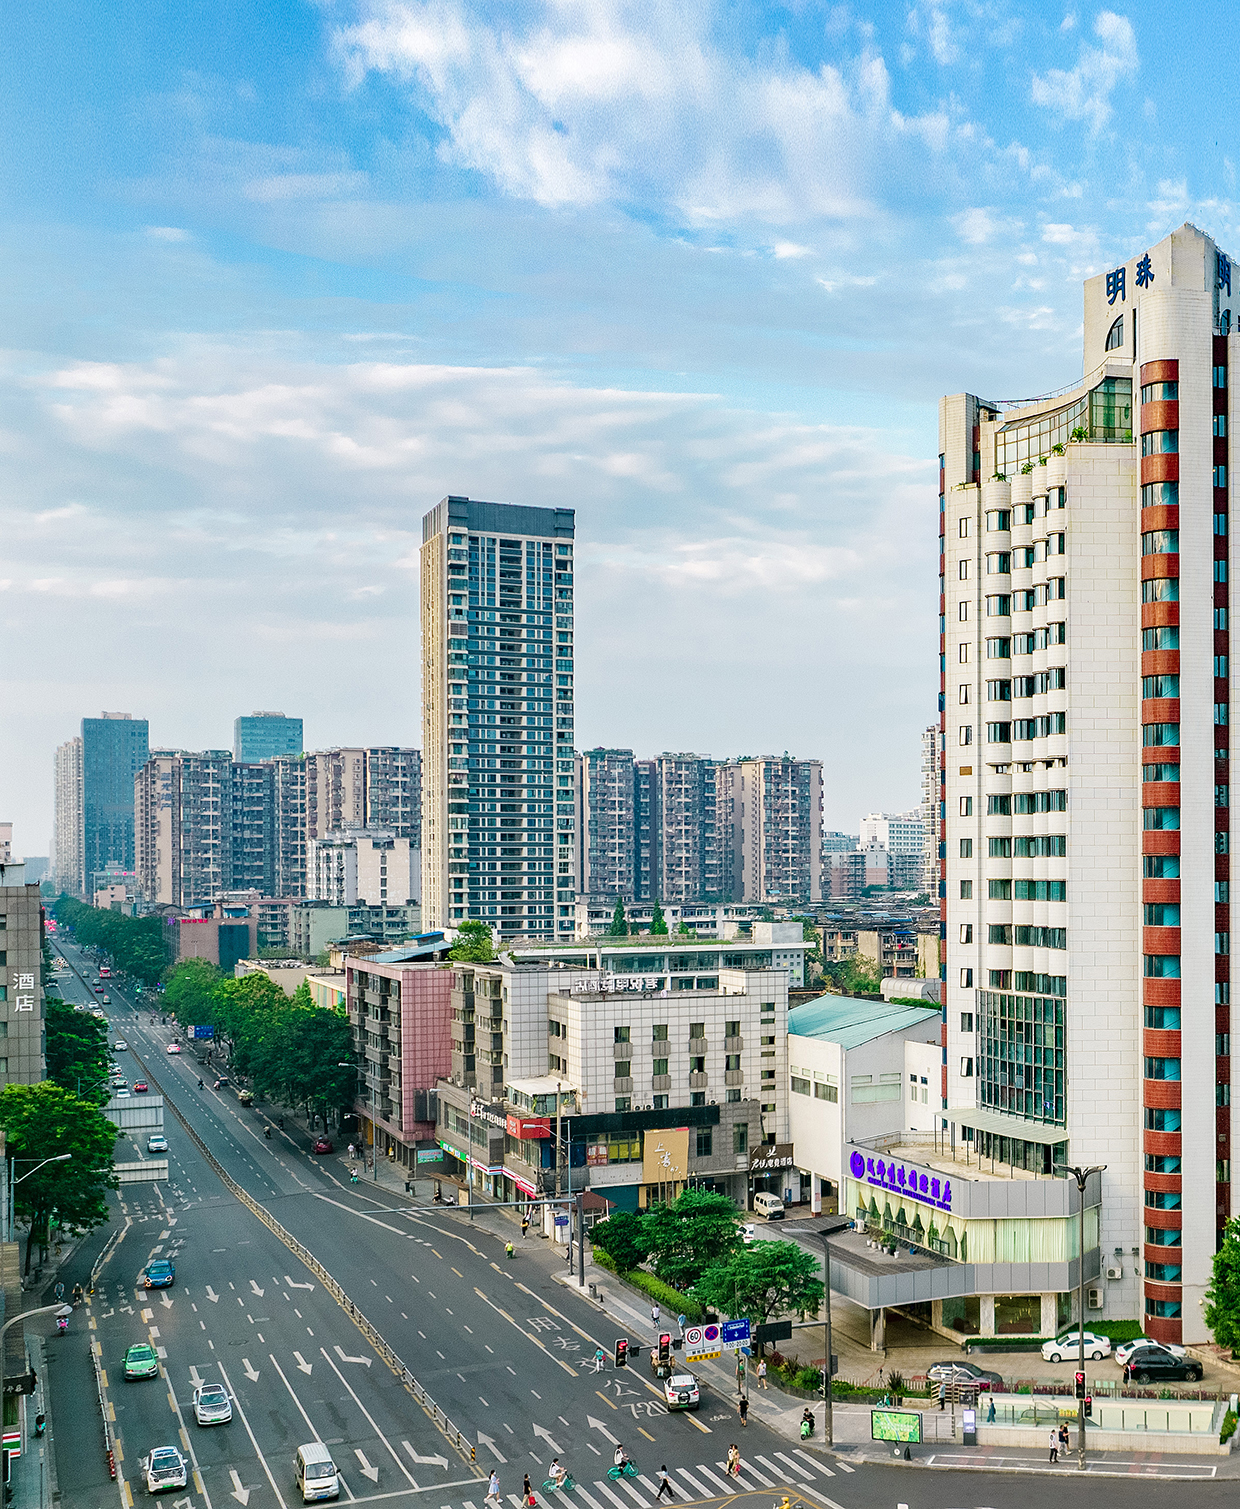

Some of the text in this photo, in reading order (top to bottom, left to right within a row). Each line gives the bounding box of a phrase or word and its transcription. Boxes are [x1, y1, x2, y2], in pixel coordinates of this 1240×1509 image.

[1106, 253, 1155, 306] 明珠
[13, 973, 35, 1013] 酒店
[690, 1332, 699, 1341] 60
